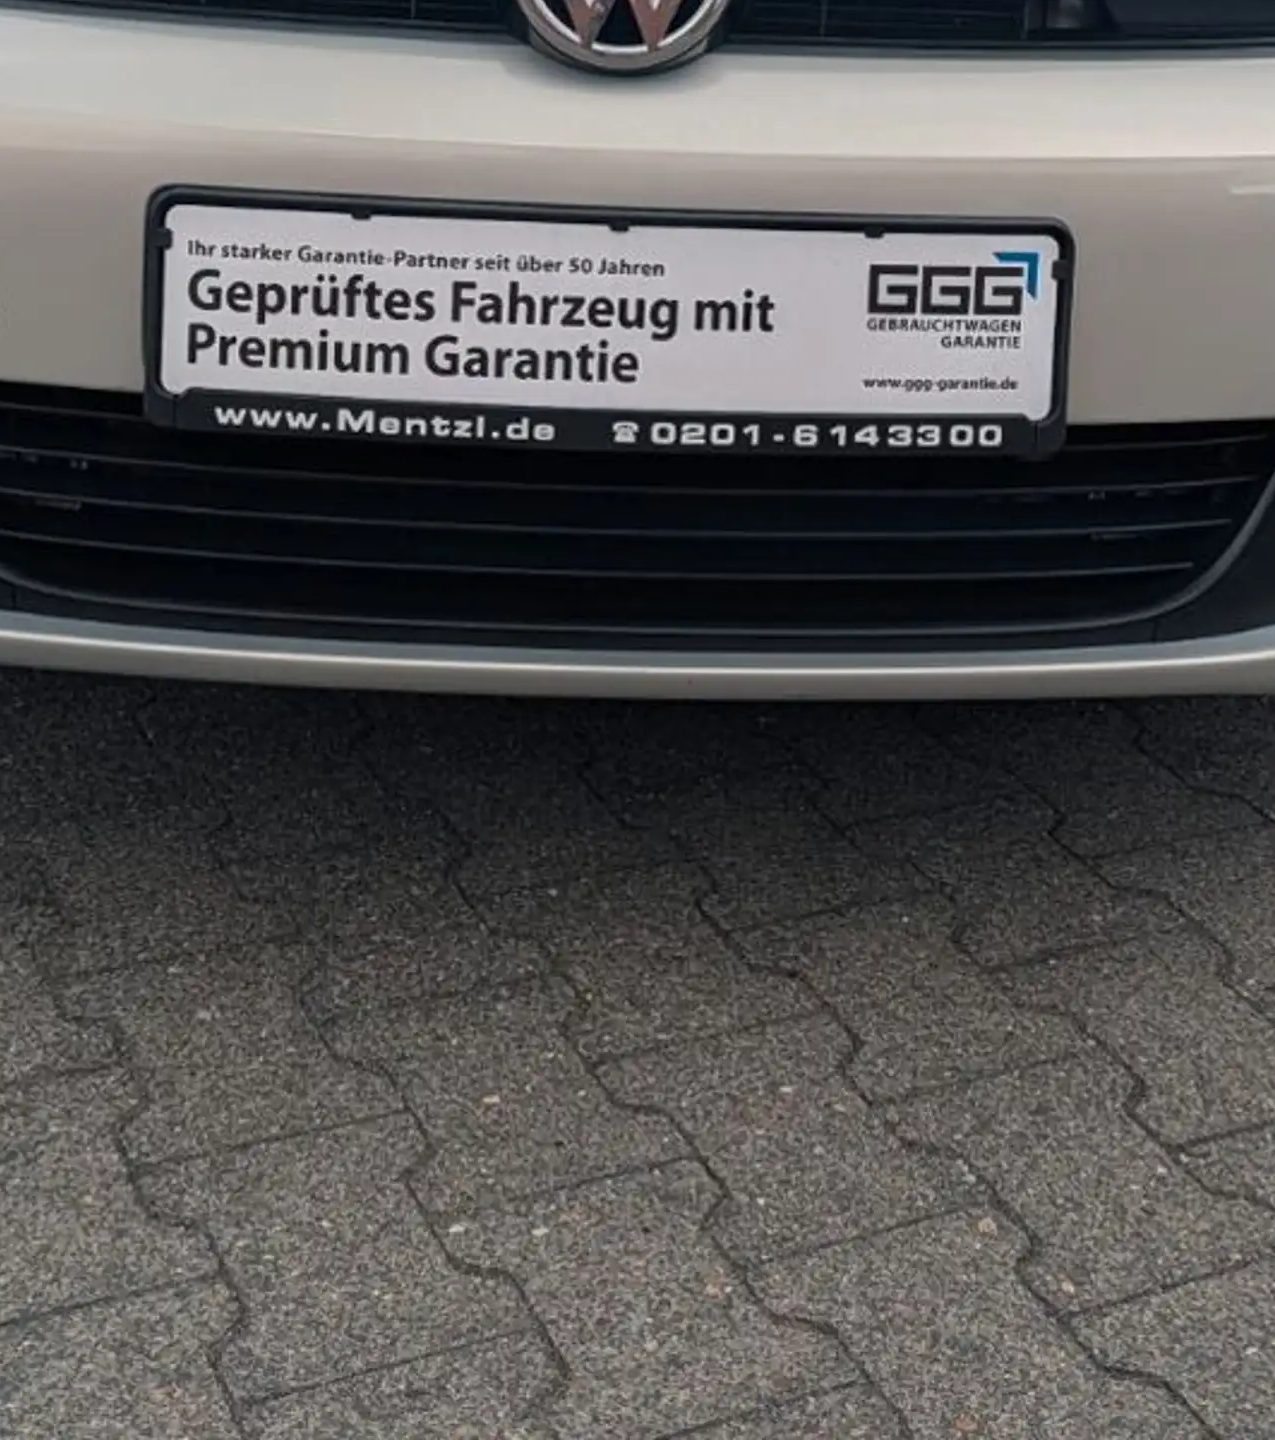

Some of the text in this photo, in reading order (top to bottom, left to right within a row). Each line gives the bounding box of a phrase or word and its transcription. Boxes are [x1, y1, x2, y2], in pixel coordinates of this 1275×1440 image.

[187, 240, 665, 277] Ihr starker Garantie-Partner seit über 50 Jahren
[187, 267, 775, 342] Geprüftes Fahrzeug mit
[867, 264, 1024, 314] GGG
[866, 318, 1022, 333] GEBRAUCHTWAGEN
[941, 335, 1021, 350] GARANTIE
[187, 322, 640, 383] Premium Garantie
[863, 376, 1018, 392] www.ggg-garantie.de
[214, 405, 556, 441] www.Mentzl.de
